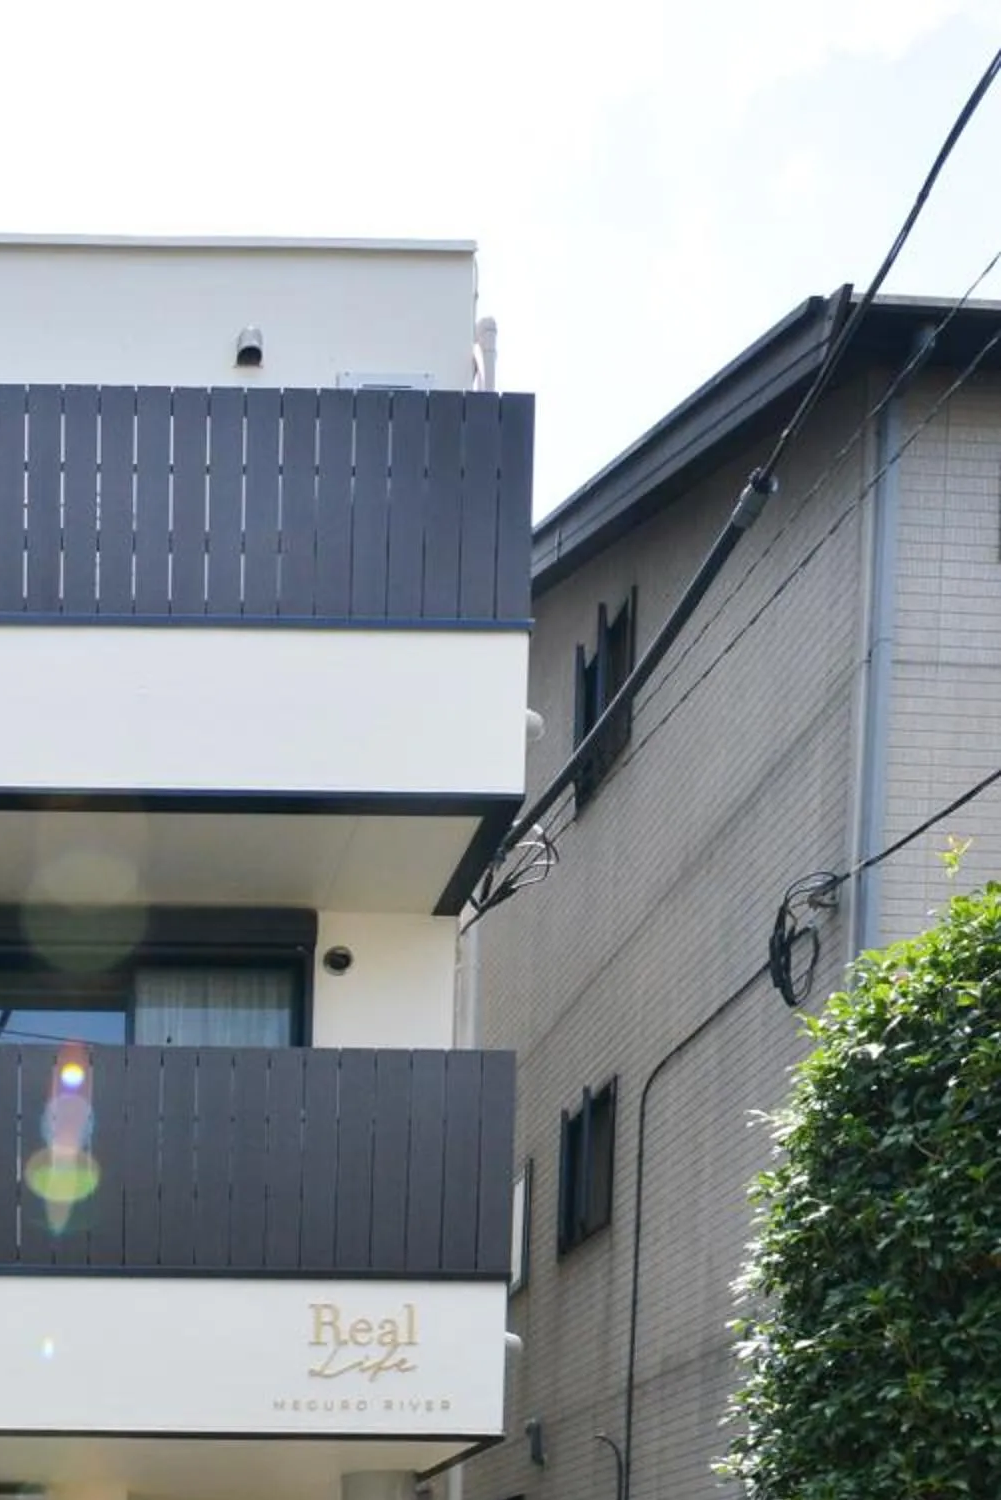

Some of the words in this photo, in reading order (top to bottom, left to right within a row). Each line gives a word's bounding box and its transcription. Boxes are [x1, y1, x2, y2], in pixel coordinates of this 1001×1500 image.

[308, 1303, 419, 1346] Real
[308, 1343, 419, 1383] Life
[272, 1399, 368, 1412] MEGURO
[383, 1399, 451, 1412] RIVER
